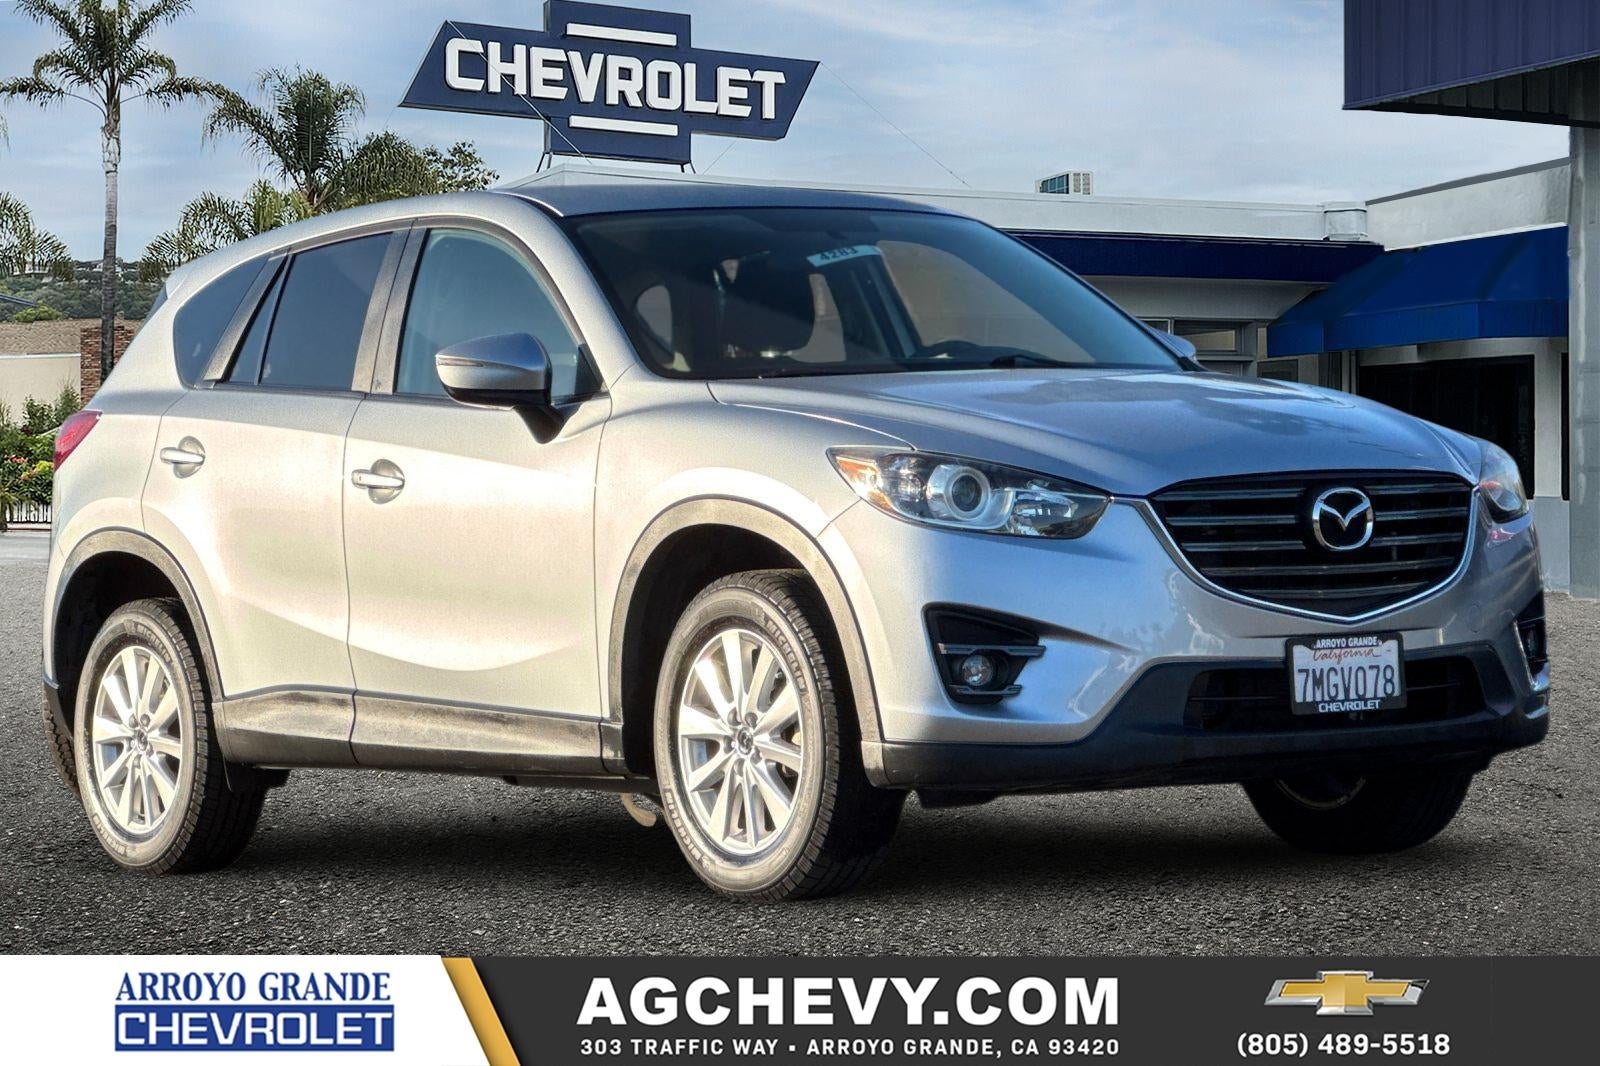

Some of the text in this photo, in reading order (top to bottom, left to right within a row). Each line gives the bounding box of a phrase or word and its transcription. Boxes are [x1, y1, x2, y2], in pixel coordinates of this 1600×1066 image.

[445, 37, 787, 120] CHEVROLET
[1316, 636, 1378, 648] ARROYO GRANDE
[1313, 648, 1381, 665] California
[1298, 664, 1395, 702] 7MGV078
[1318, 700, 1380, 713] CHEVROLET
